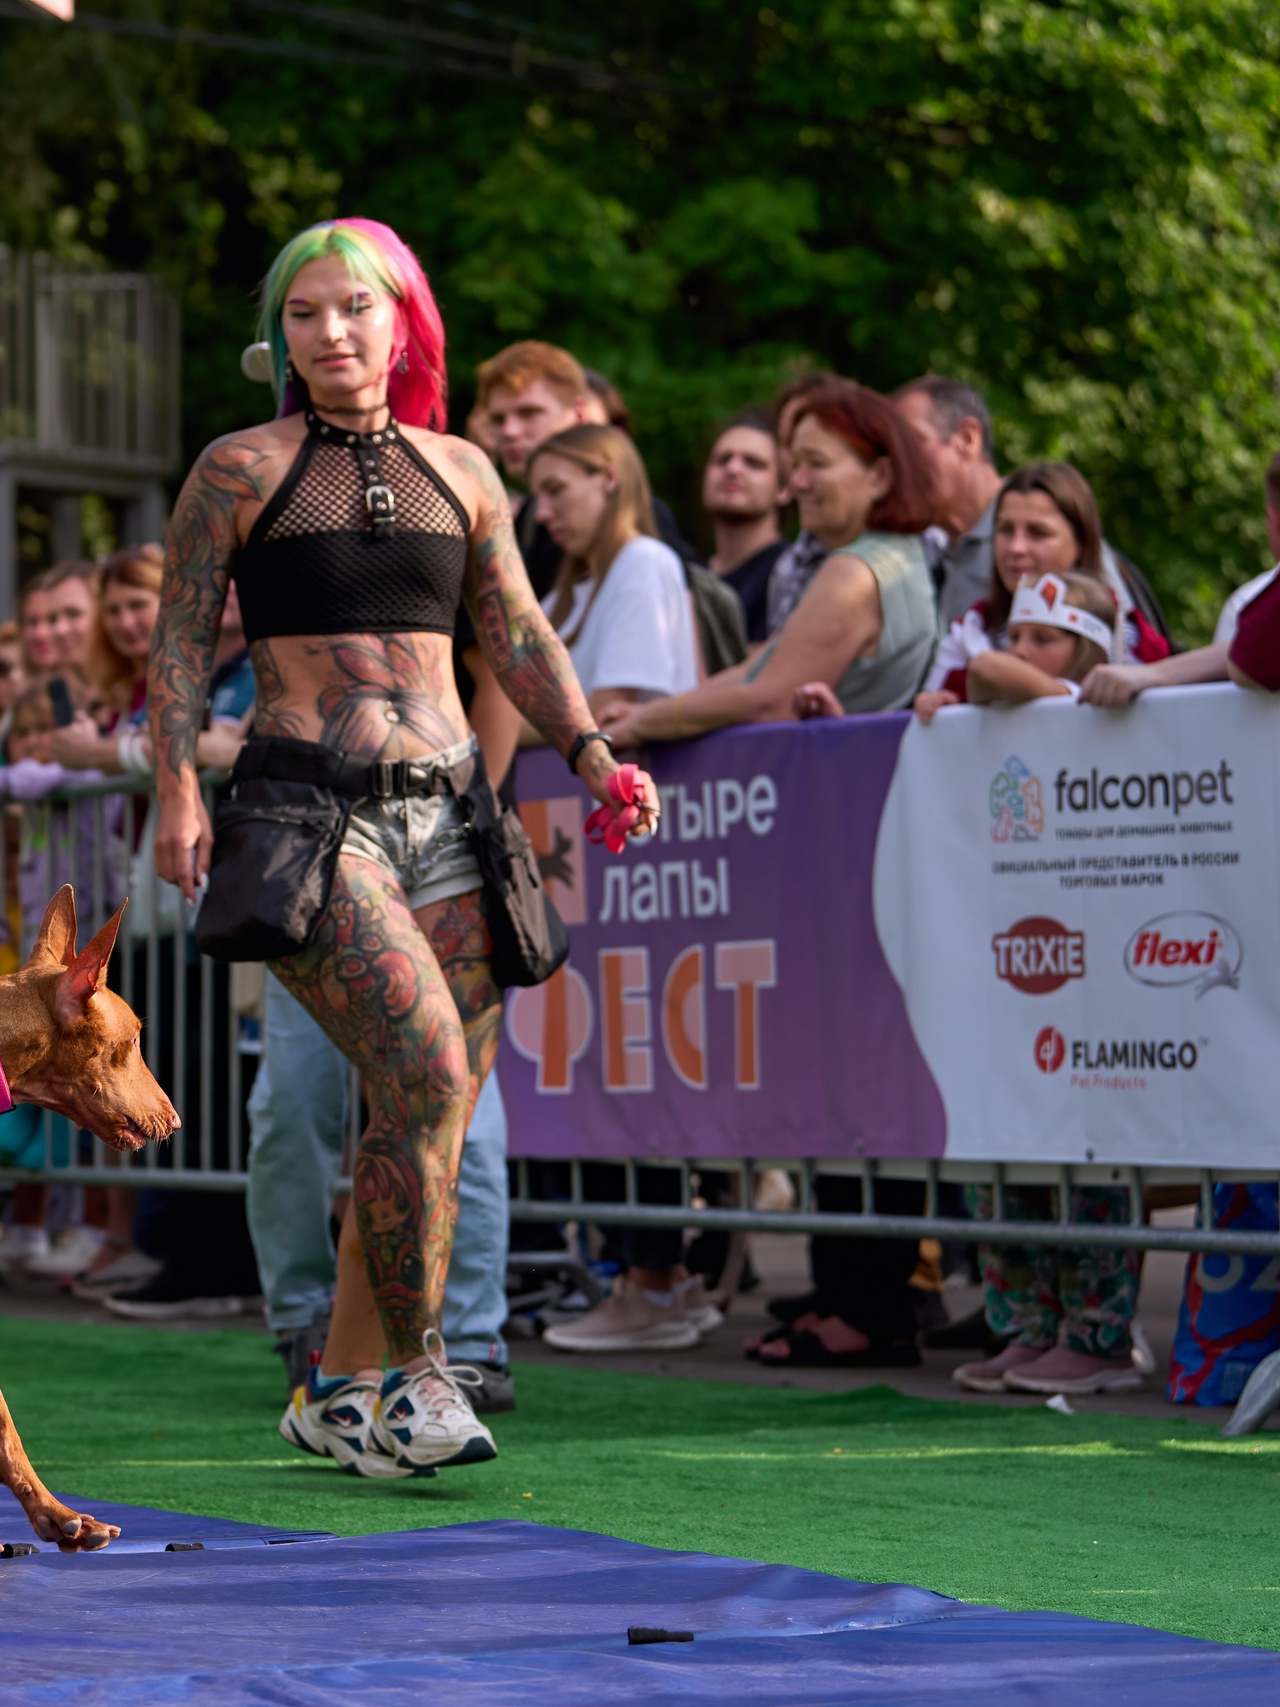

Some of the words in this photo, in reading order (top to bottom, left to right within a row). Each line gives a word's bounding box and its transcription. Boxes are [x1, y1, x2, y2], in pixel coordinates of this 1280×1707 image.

[592, 774, 777, 846] тыре
[1054, 760, 1234, 815] falconpet
[1120, 872, 1164, 887] МАРОК
[1192, 851, 1240, 867] РОССИИ
[599, 857, 730, 924] лапы
[1133, 929, 1218, 966] flexi
[506, 938, 777, 1094] ФЕСТ
[1072, 1040, 1198, 1070] FLAMINGO
